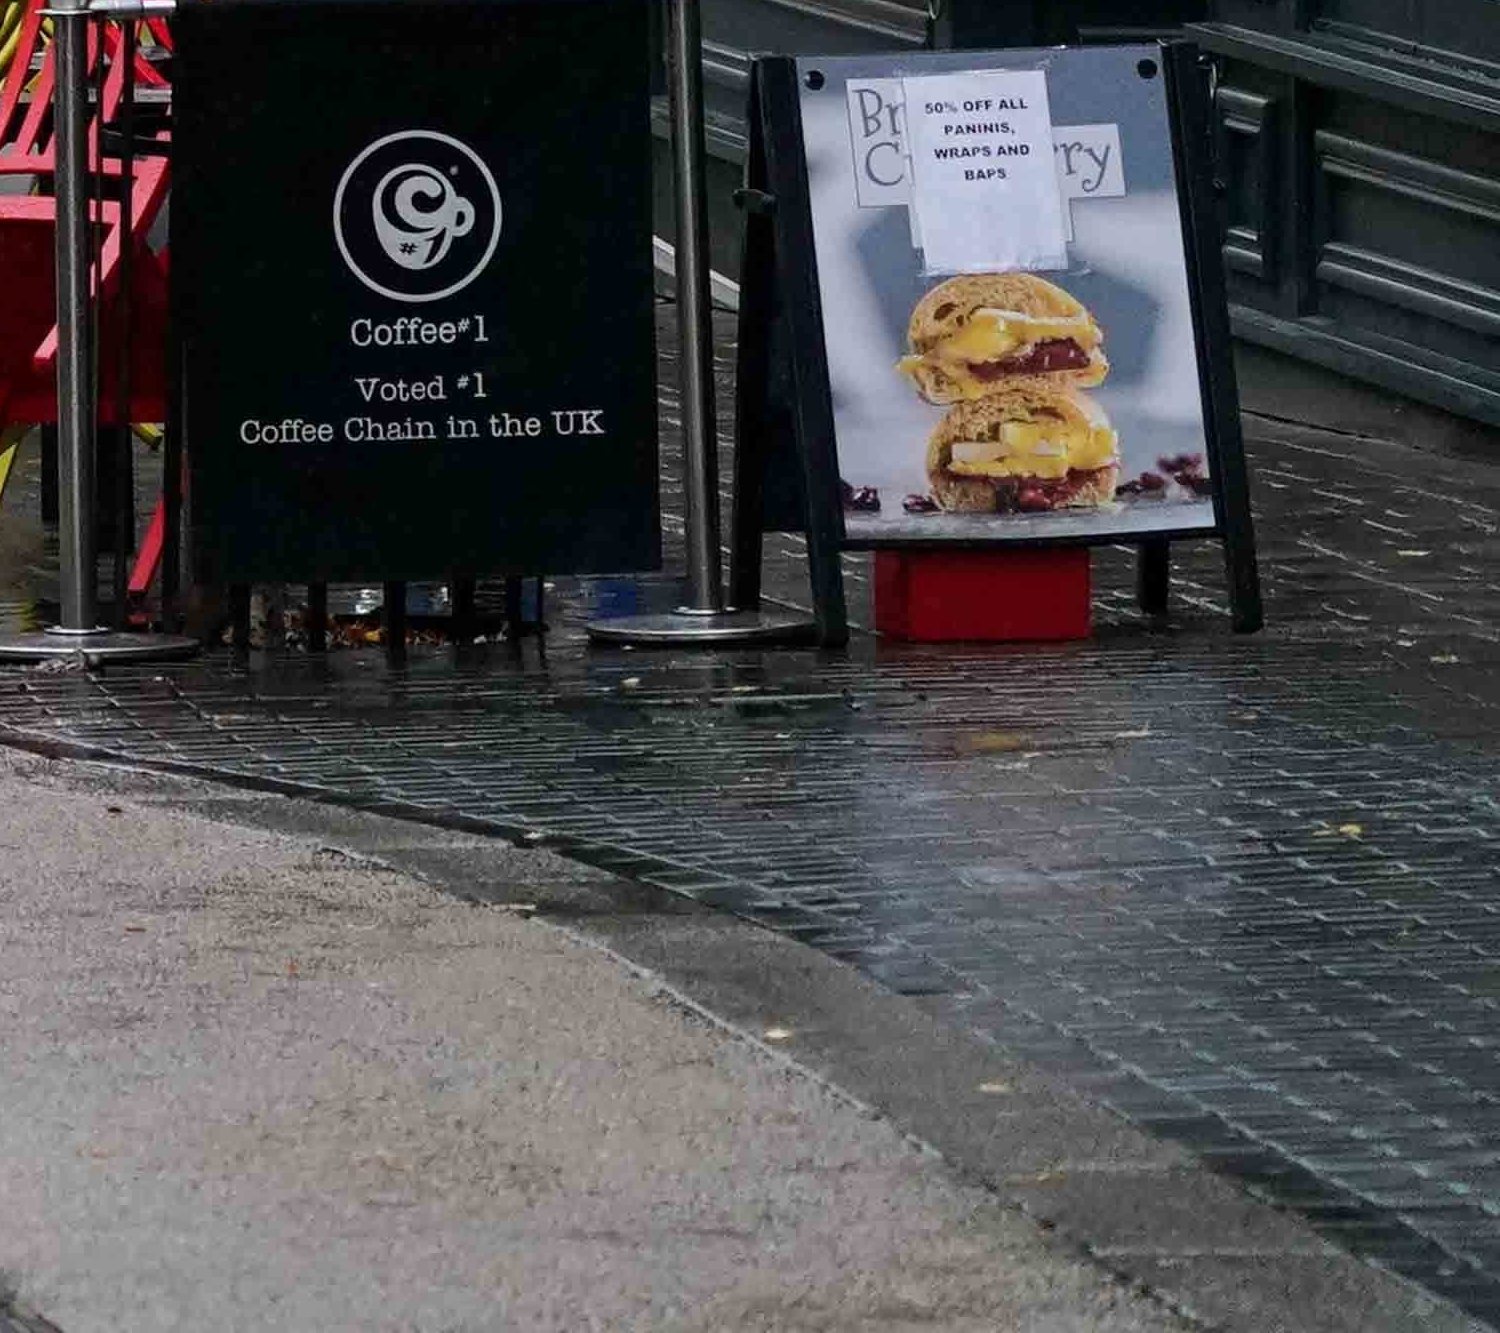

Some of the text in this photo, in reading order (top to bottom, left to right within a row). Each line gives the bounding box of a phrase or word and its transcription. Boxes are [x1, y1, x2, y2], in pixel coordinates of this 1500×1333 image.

[924, 98, 1029, 116] 50% OFF ALL
[943, 122, 1017, 137] PANINIS,
[933, 143, 1031, 160] WRAPS AND
[963, 167, 1008, 182] BAPS
[350, 314, 489, 347] Coffee#1
[354, 373, 487, 402] Voted #1
[240, 409, 605, 444] Coffee Chain in the UK
